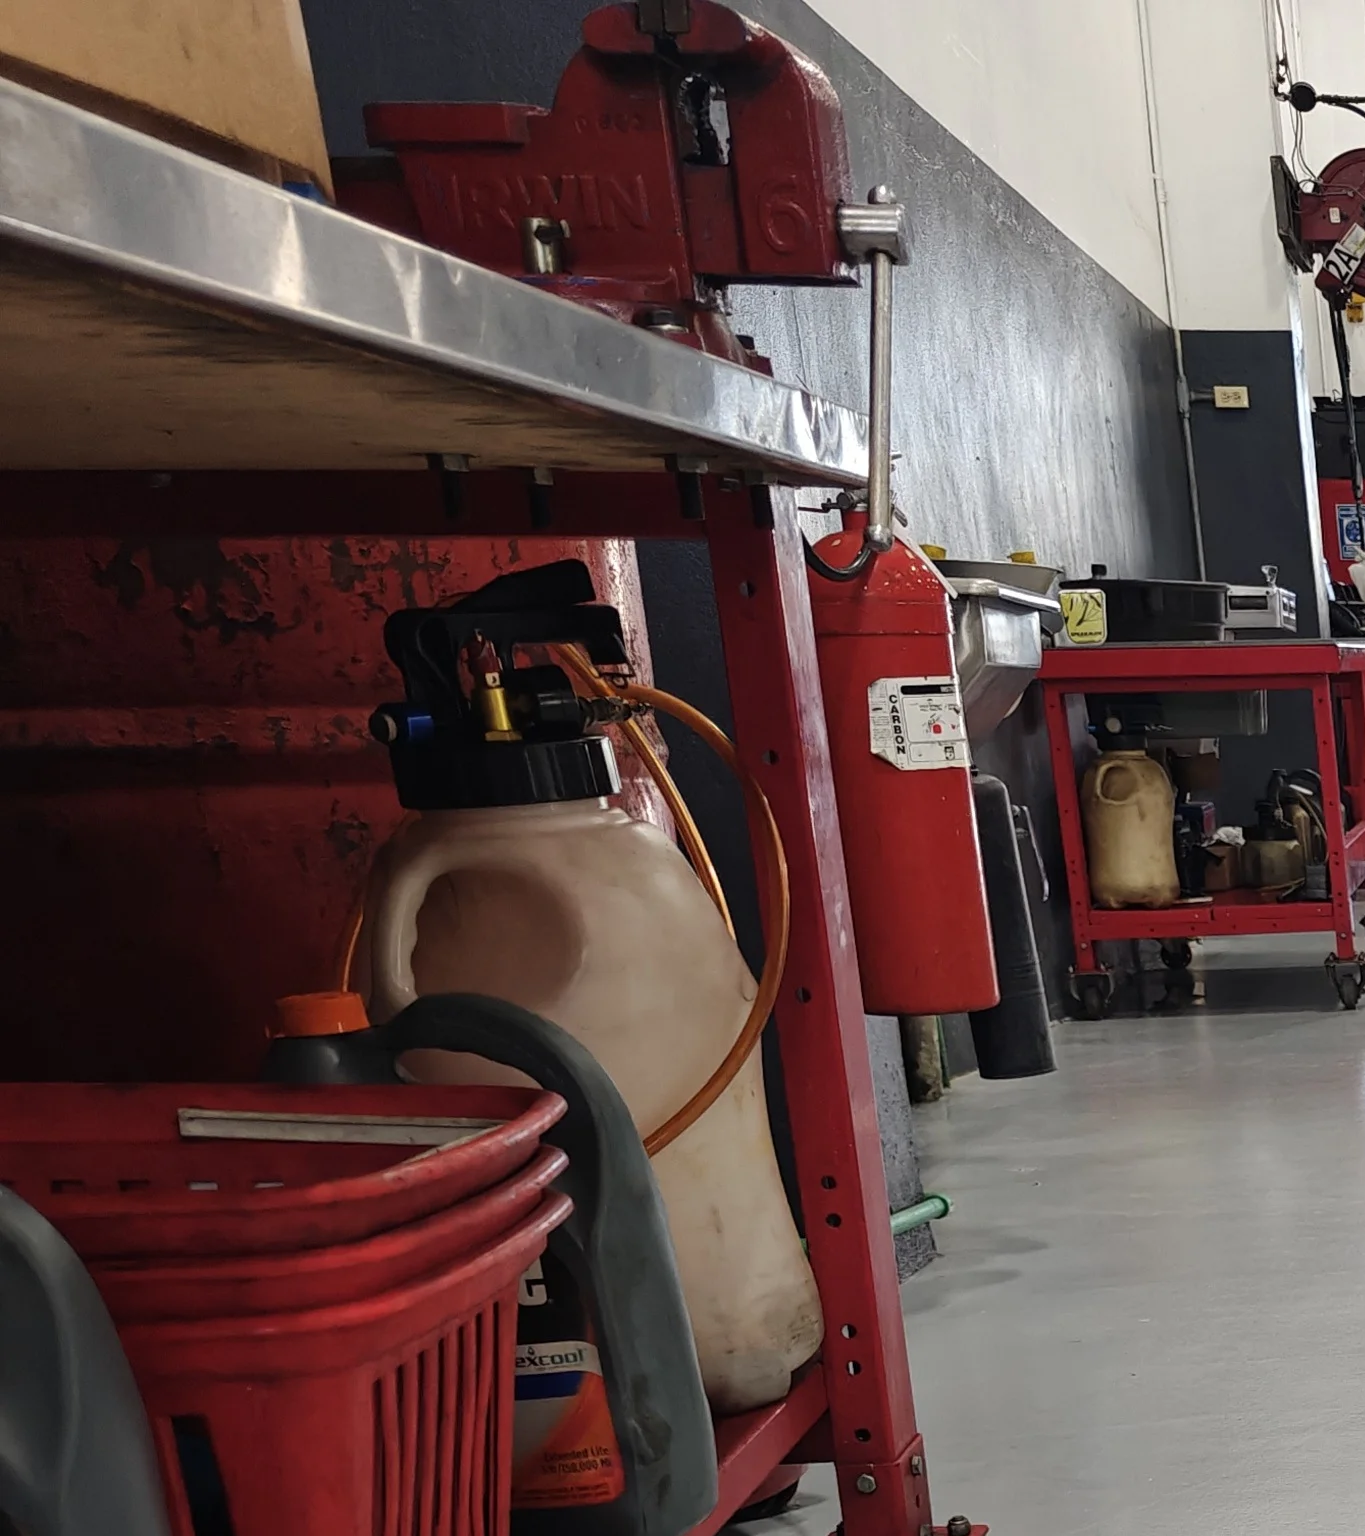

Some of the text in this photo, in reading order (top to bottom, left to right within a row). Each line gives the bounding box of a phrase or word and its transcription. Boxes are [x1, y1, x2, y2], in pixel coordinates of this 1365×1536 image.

[449, 173, 650, 232] IRWIN
[756, 172, 812, 255] 6
[1325, 248, 1360, 282] 2A
[889, 694, 906, 755] CARBON
[515, 1347, 584, 1368] excool
